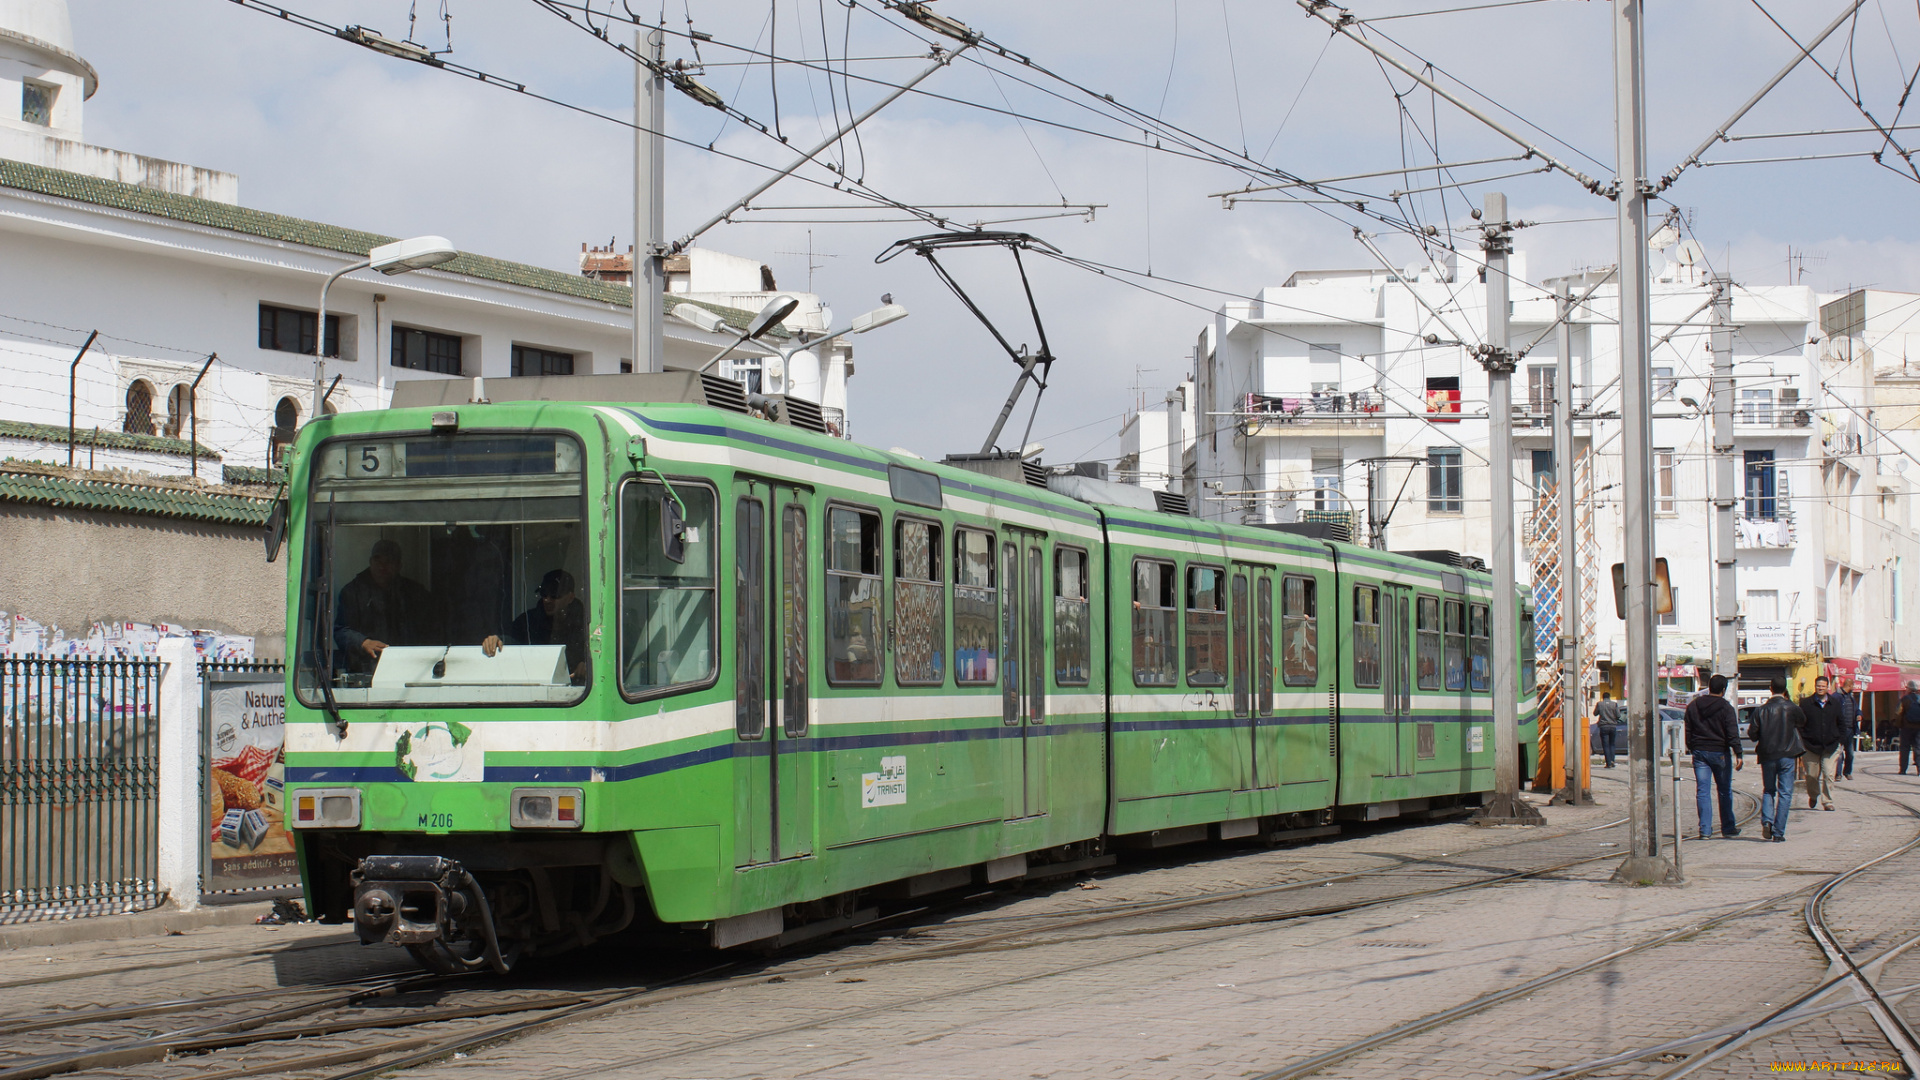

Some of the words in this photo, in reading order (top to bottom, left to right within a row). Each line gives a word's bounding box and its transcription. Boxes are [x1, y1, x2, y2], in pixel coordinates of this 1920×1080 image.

[361, 446, 380, 473] 5
[245, 690, 285, 708] Nature
[241, 713, 250, 730] &
[877, 783, 905, 795] TRANSTU
[418, 813, 428, 827] M
[431, 813, 453, 828] 206
[223, 862, 241, 872] Sans
[243, 858, 272, 870] additifs
[278, 857, 296, 867] Sans
